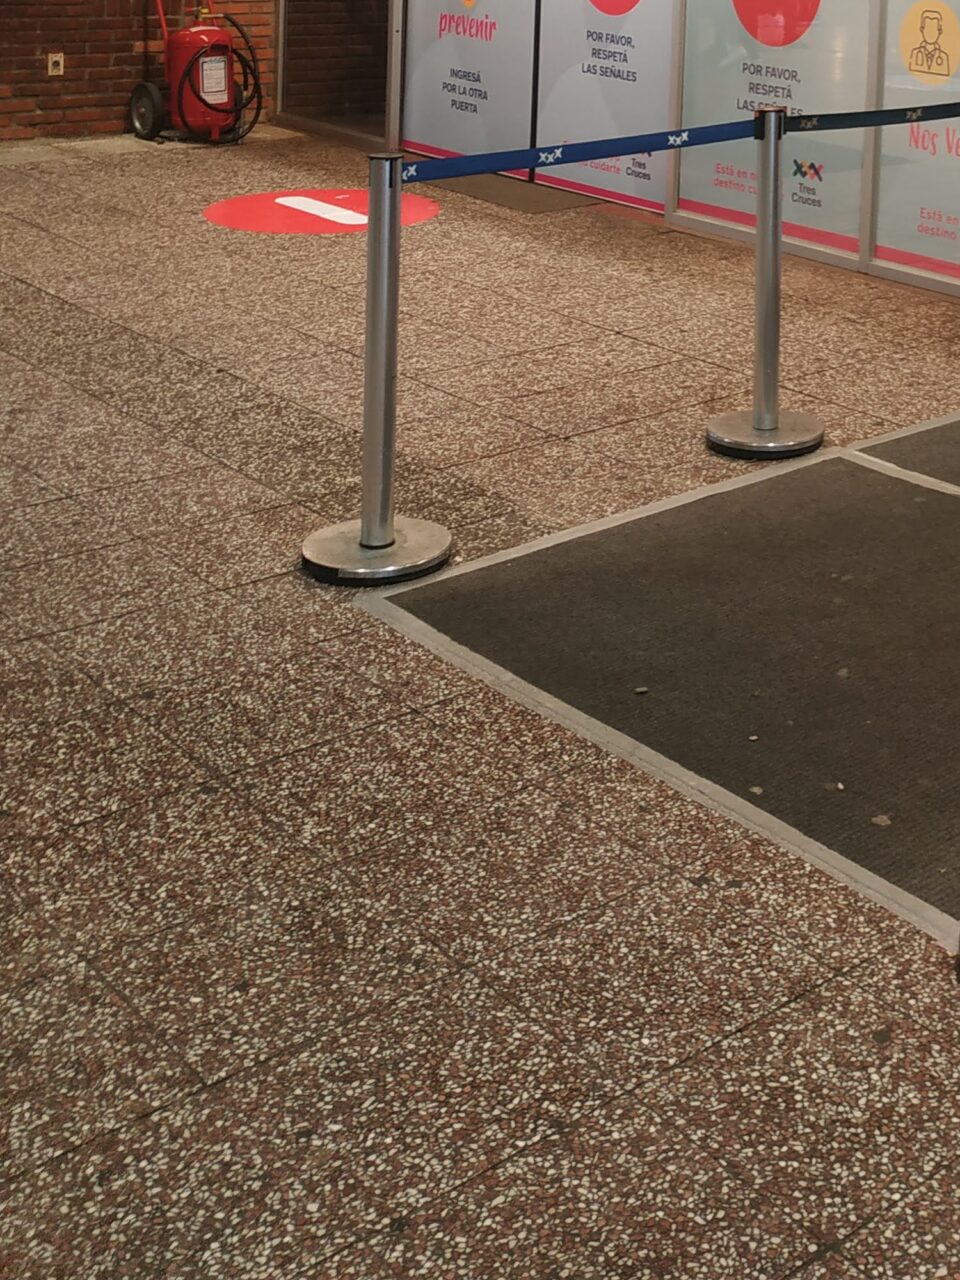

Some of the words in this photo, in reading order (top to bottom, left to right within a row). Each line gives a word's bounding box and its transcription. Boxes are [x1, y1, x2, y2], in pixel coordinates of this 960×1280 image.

[438, 11, 497, 42] prevenir
[586, 30, 603, 43] POR
[605, 33, 635, 48] FAVOR,
[591, 48, 628, 64] RESPETÁ
[450, 68, 482, 83] INGRESÁ
[581, 63, 597, 76] LAS
[598, 64, 638, 83] SEÑALES
[742, 62, 764, 77] POR
[765, 65, 801, 83] FAVOR,
[442, 81, 457, 94] POR
[458, 84, 467, 96] LA
[468, 88, 488, 101] OTRA
[748, 82, 792, 100] RESPETÁ
[450, 99, 478, 114] PUERTA
[736, 98, 755, 111] LAS
[908, 120, 937, 156] Nos
[632, 158, 646, 170] Tres
[625, 167, 651, 181] Cruces
[798, 183, 816, 196] Tres
[791, 192, 822, 208] Cruces
[919, 207, 943, 223] Está
[945, 215, 959, 227] en
[916, 222, 957, 241] destino
